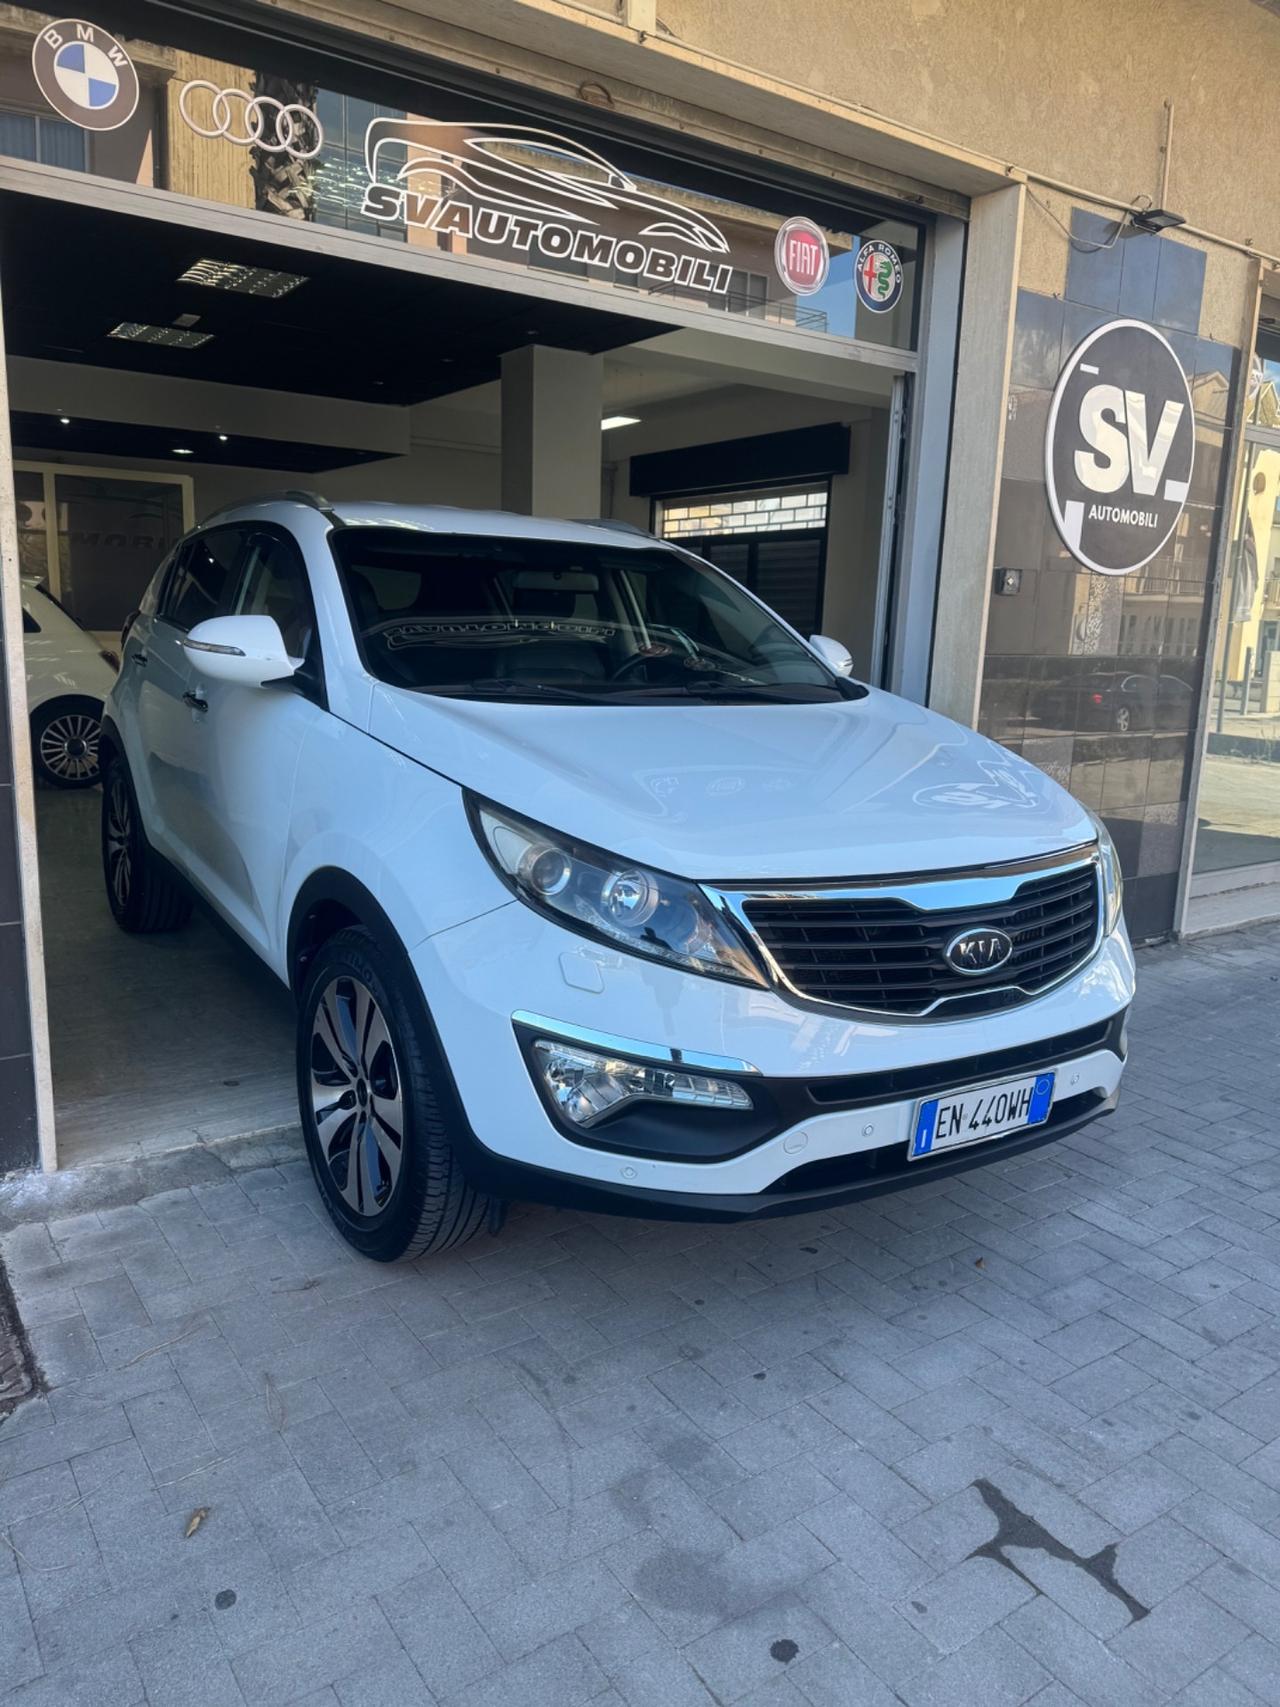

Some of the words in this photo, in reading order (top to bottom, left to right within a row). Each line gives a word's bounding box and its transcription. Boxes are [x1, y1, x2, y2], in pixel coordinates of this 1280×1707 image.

[43, 23, 128, 68] BMW
[789, 239, 819, 276] FIAT
[857, 244, 875, 272] ALFA
[878, 243, 901, 284] ROMEO
[1074, 384, 1184, 496] SV
[1088, 504, 1159, 528] AUTOMOBILI
[959, 938, 1001, 965] KIA
[936, 1104, 964, 1139] EN
[968, 1087, 1034, 1131] 440WH
